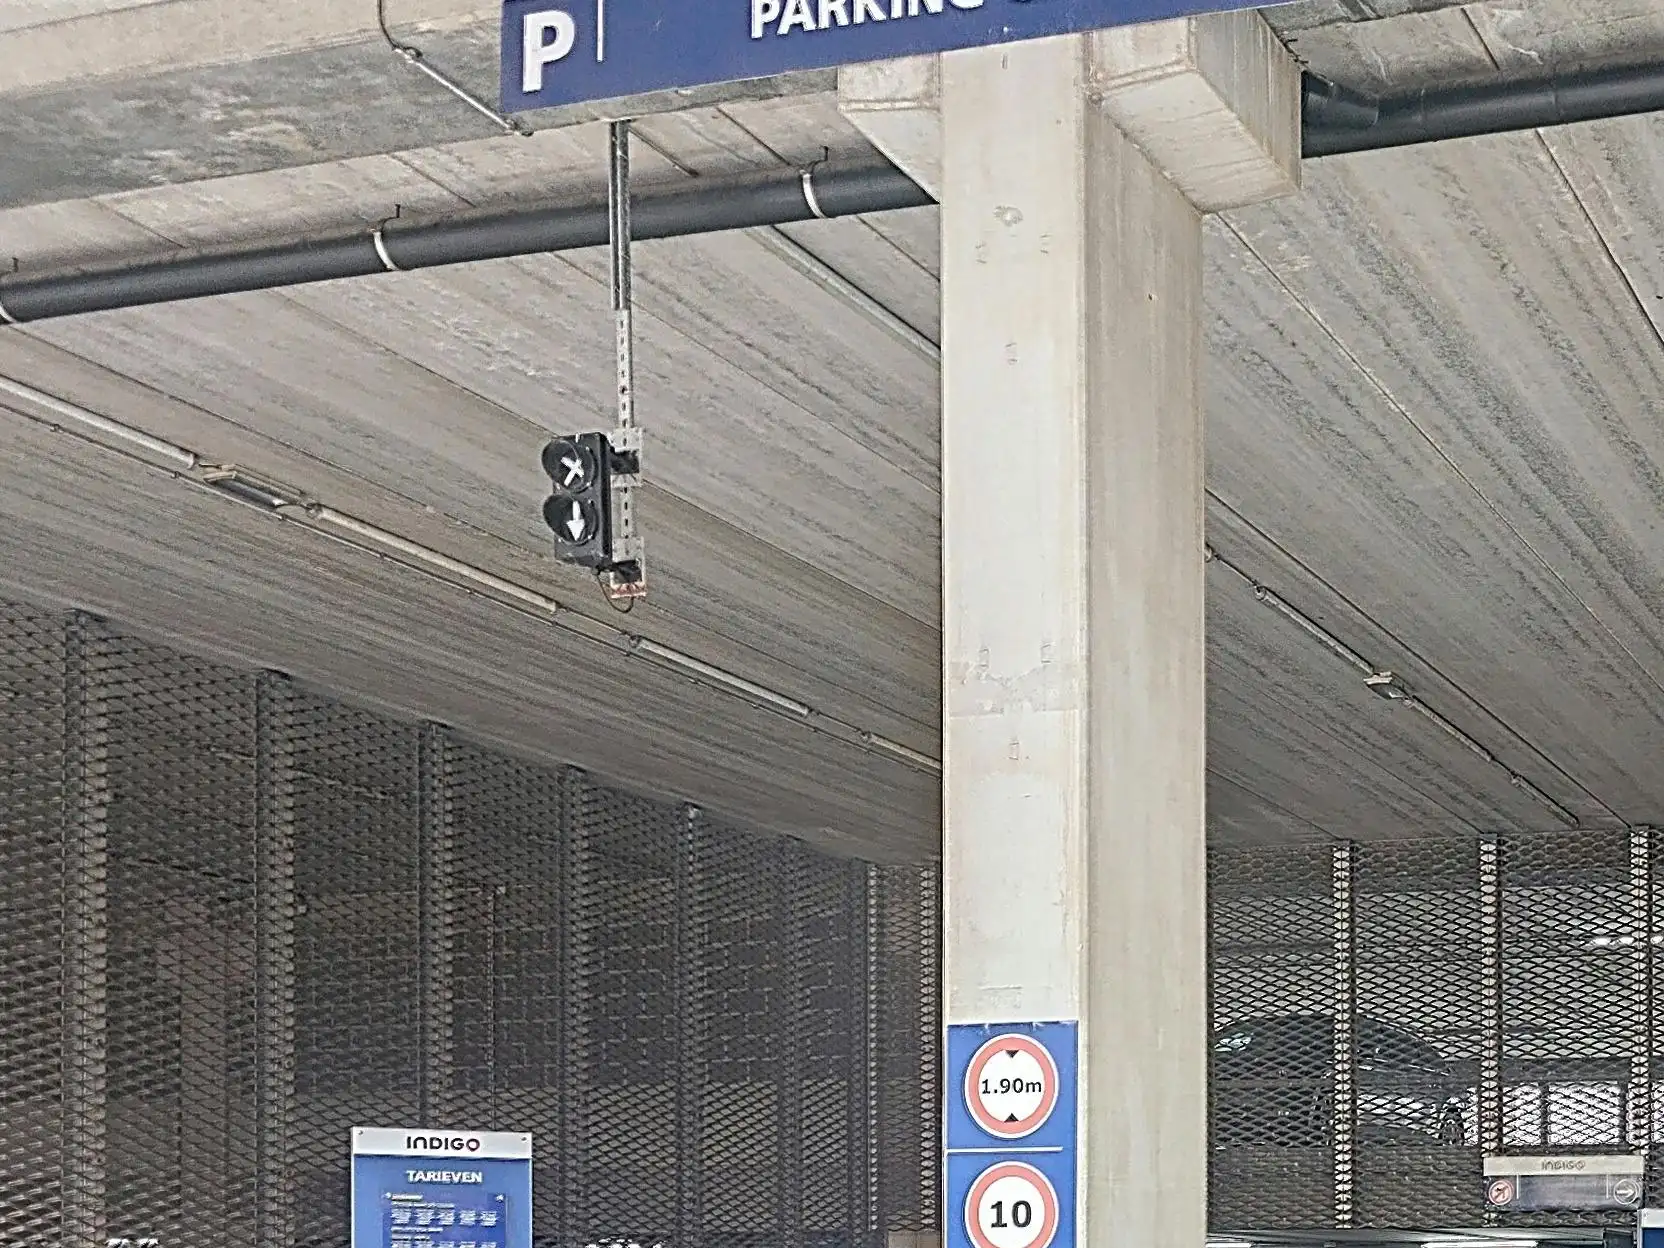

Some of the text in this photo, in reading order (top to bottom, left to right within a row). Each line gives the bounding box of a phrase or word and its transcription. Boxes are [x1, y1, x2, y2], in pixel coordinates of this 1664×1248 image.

[750, 0, 985, 39] PARK
[522, 10, 575, 92] P
[981, 1078, 1042, 1095] 1.90m
[406, 1136, 481, 1152] INDIGO
[406, 1170, 483, 1184] TARIEVEN
[990, 1200, 1032, 1228] 10
